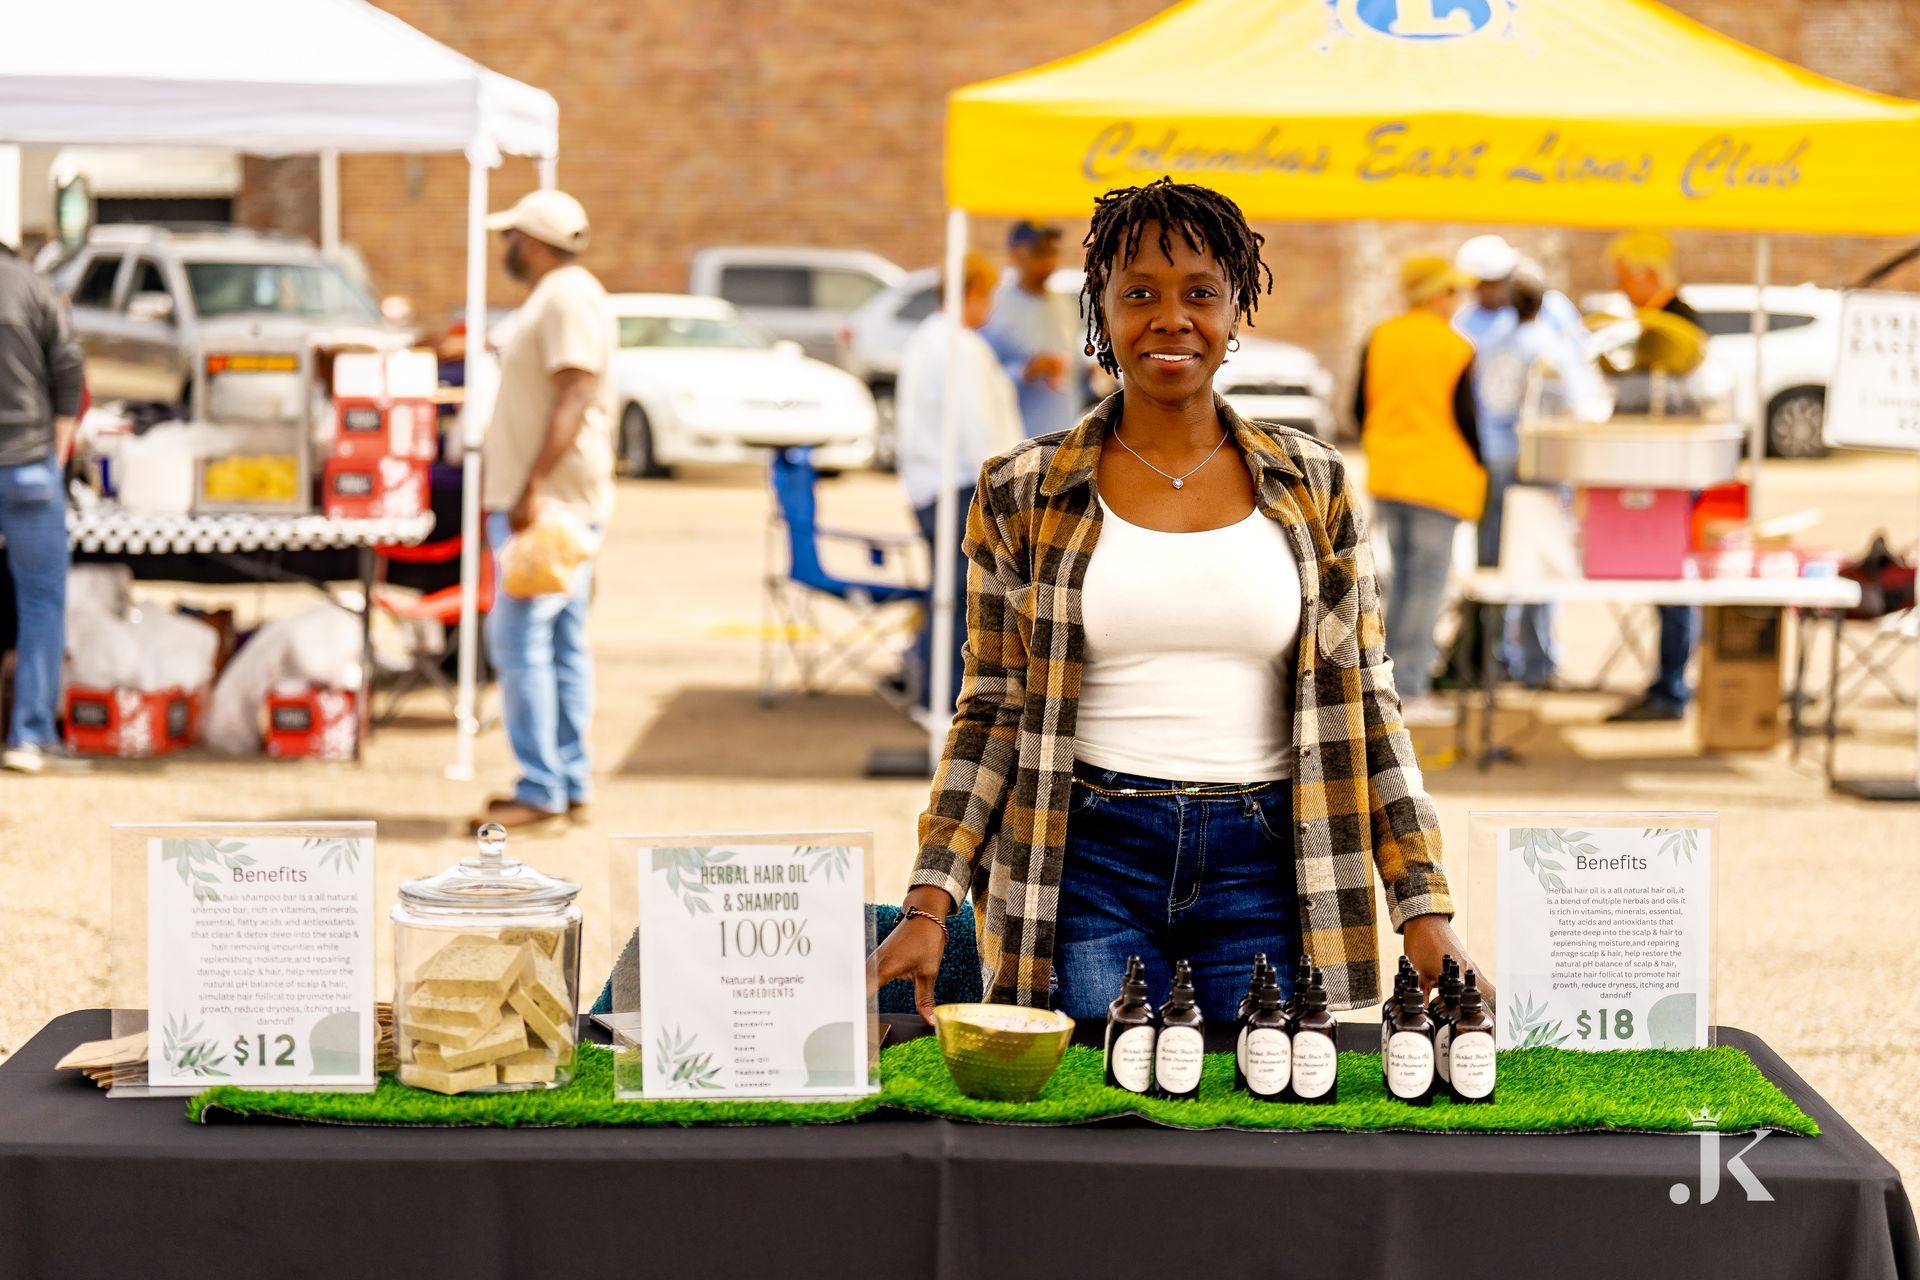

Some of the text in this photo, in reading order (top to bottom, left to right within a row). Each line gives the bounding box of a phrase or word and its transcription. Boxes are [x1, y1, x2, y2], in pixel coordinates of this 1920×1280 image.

[1082, 122, 1810, 200] Columbus East Lions Club
[1576, 855, 1647, 870] Benefits
[232, 866, 308, 882] Benefits
[701, 865, 808, 885] HERBAL HAIR OIL
[1666, 887, 1678, 895] oil,
[723, 892, 799, 912] & SHAMPOO
[1591, 898, 1621, 906] multiple
[1581, 908, 1613, 916] vitamins,
[1615, 908, 1648, 916] minerals,
[1649, 908, 1683, 916] essential,
[1559, 919, 1576, 927] fatty
[720, 918, 811, 957] 100%
[1550, 929, 1581, 938] generate
[1582, 929, 1602, 938] deep
[1632, 929, 1651, 938] scalp
[1553, 940, 1597, 948] replenishing
[1648, 940, 1679, 948] repairing
[1550, 950, 1579, 959] damage
[1580, 950, 1600, 959] scalp
[1607, 950, 1623, 958] hair,
[1625, 950, 1641, 959] help
[1583, 960, 1594, 969] pH
[1633, 960, 1653, 969] scalp
[1661, 960, 1677, 968] hair,
[1634, 971, 1665, 980] promote
[721, 975, 805, 988] Natural & organic
[1552, 981, 1580, 990] growth,
[1608, 981, 1639, 990] dryness,
[1640, 981, 1664, 990] itching
[732, 988, 795, 999] INGREDIENTS
[1576, 1008, 1634, 1040] $18
[234, 1034, 296, 1066] $12
